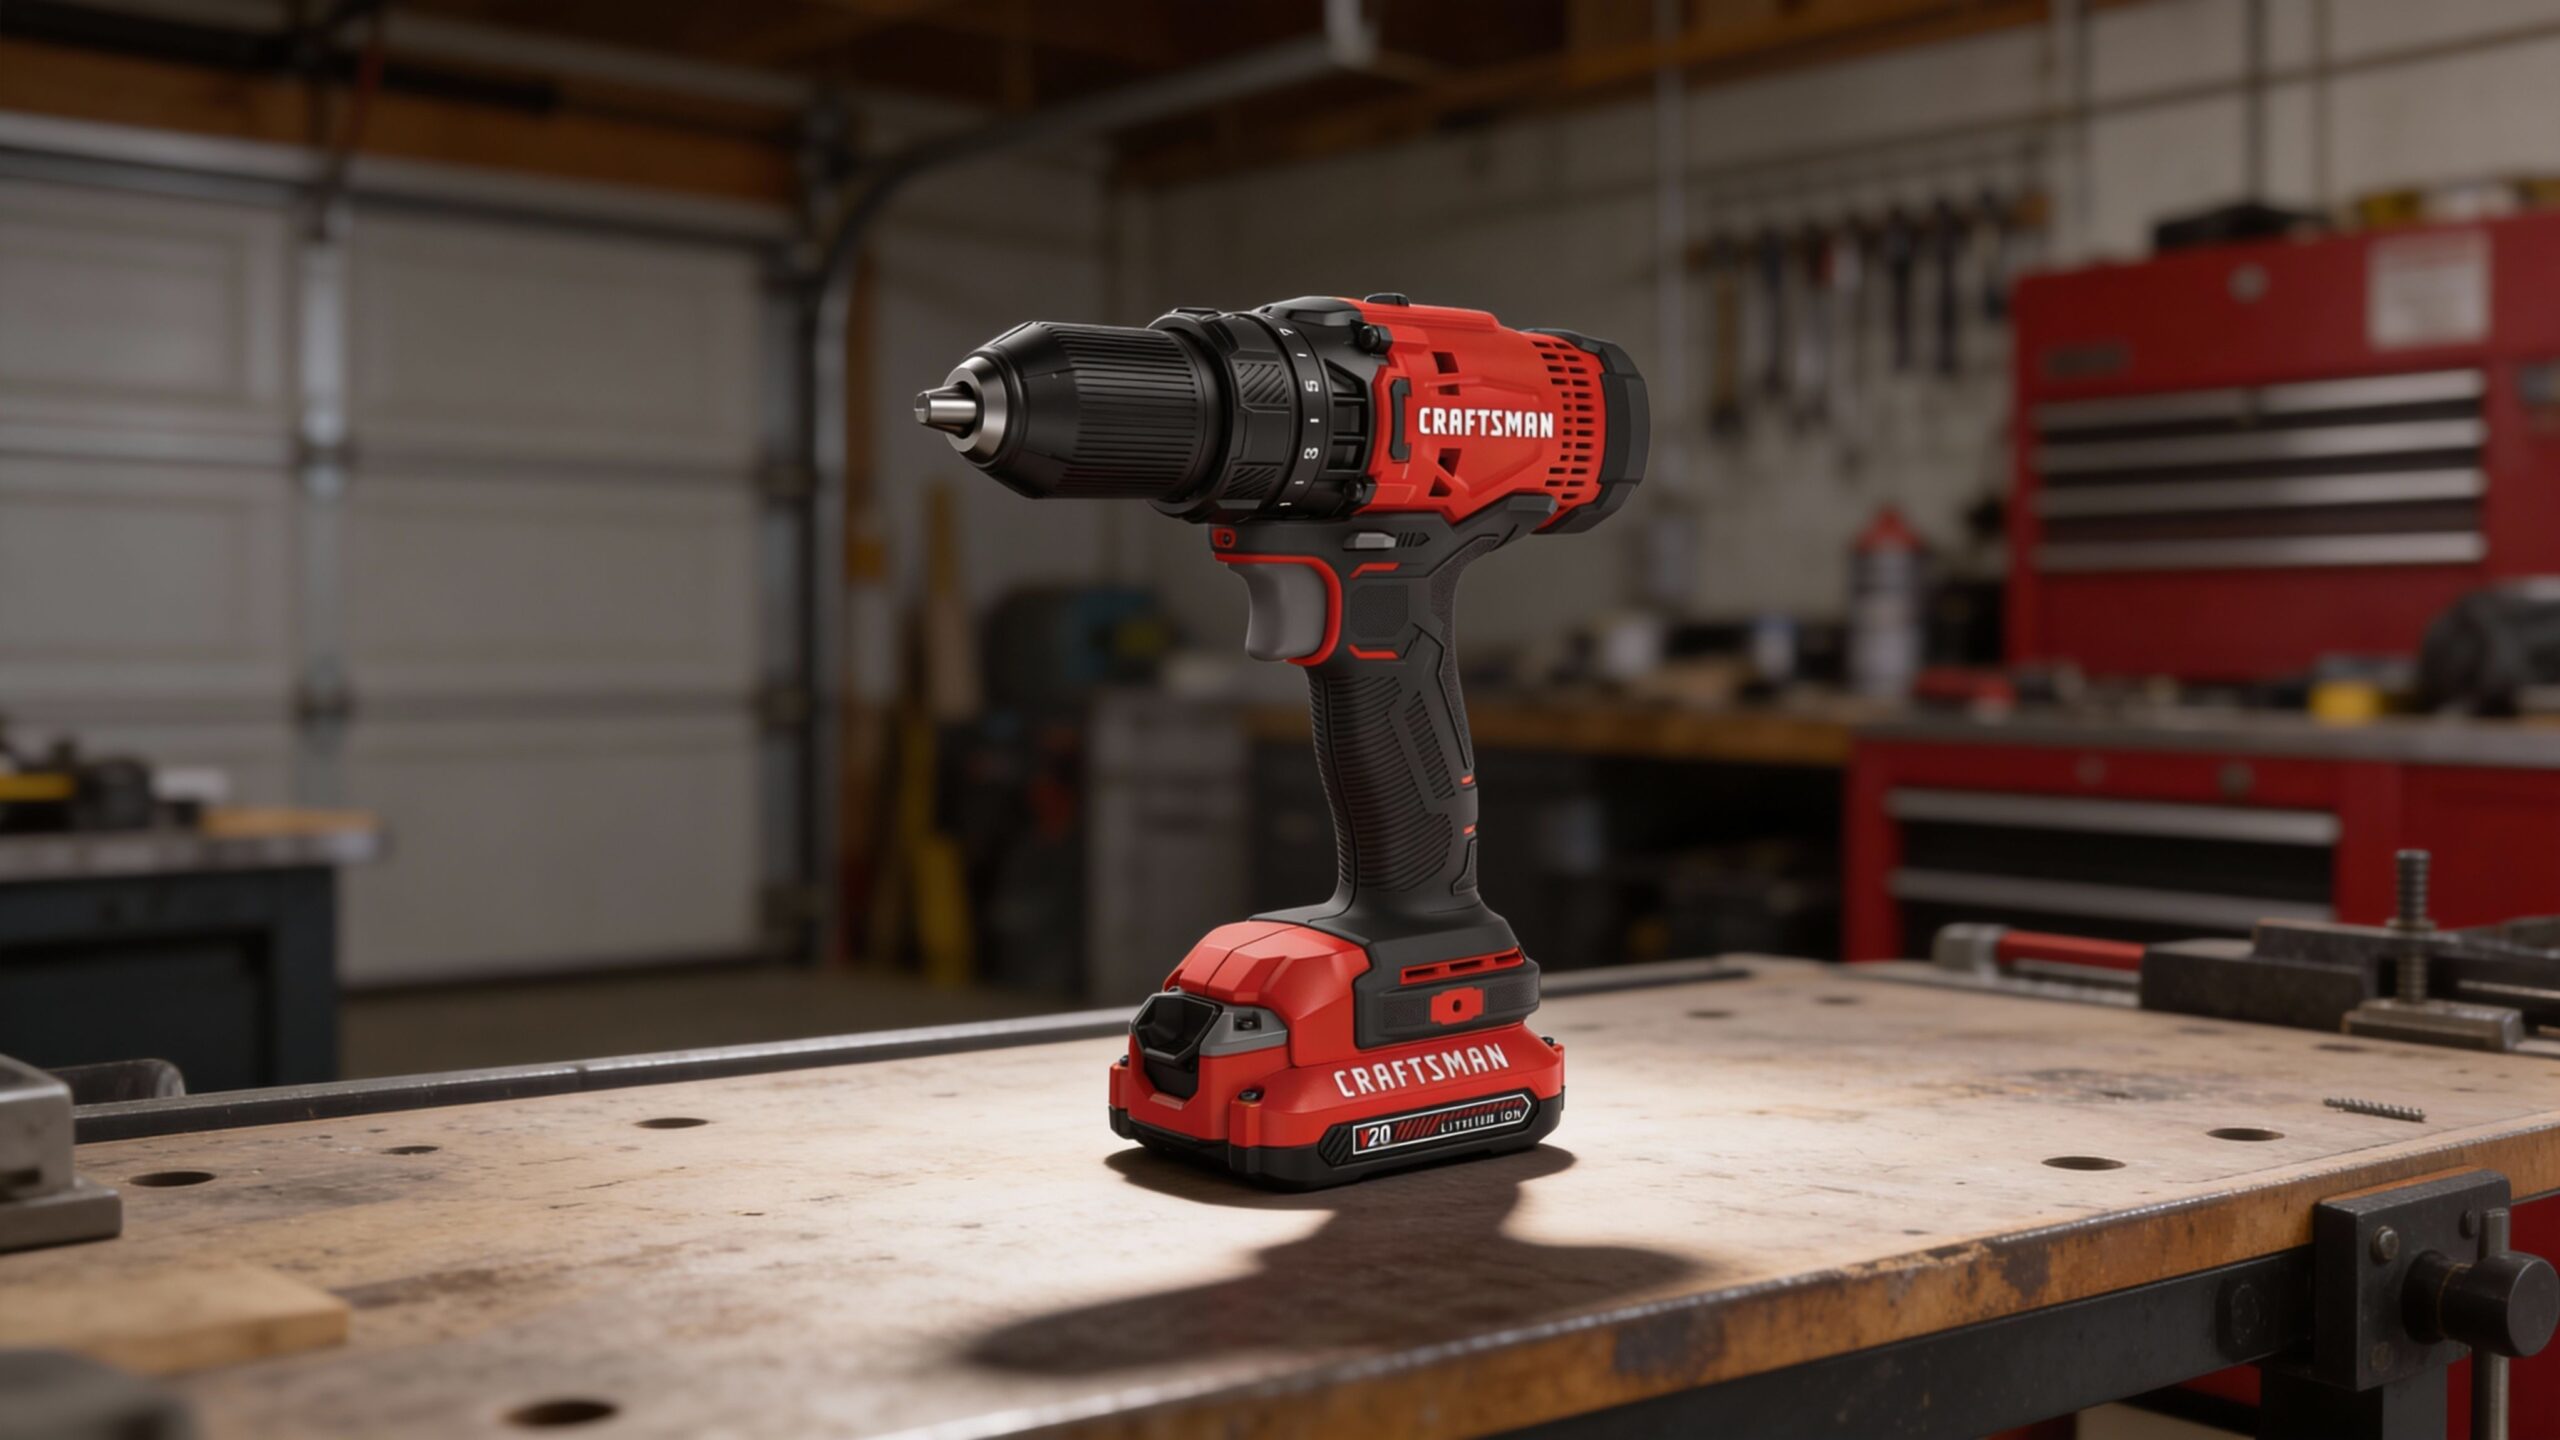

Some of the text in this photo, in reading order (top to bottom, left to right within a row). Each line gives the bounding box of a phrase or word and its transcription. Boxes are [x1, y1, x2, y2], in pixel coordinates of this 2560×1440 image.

[1304, 379, 1319, 392] 5
[1418, 406, 1554, 438] CRAFTSMAN
[1333, 1042, 1510, 1097] CRAFTSMAN
[1358, 1124, 1391, 1150] V20
